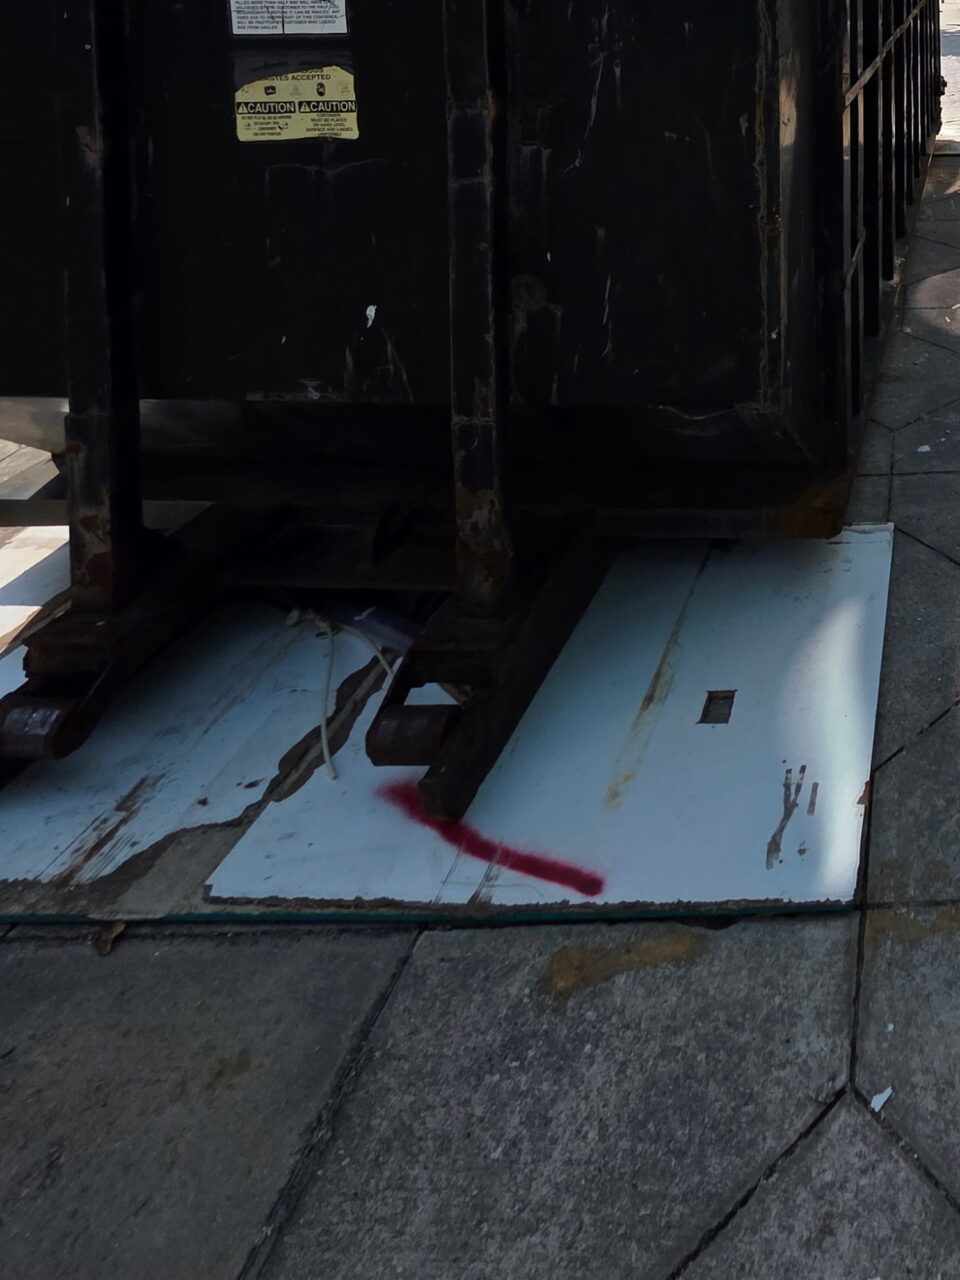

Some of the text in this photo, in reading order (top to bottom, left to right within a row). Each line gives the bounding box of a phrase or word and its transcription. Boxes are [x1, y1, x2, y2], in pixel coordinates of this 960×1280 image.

[291, 73, 331, 81] ACCEPTED
[247, 102, 294, 113] CAUTION
[310, 101, 356, 112] CAUTION
